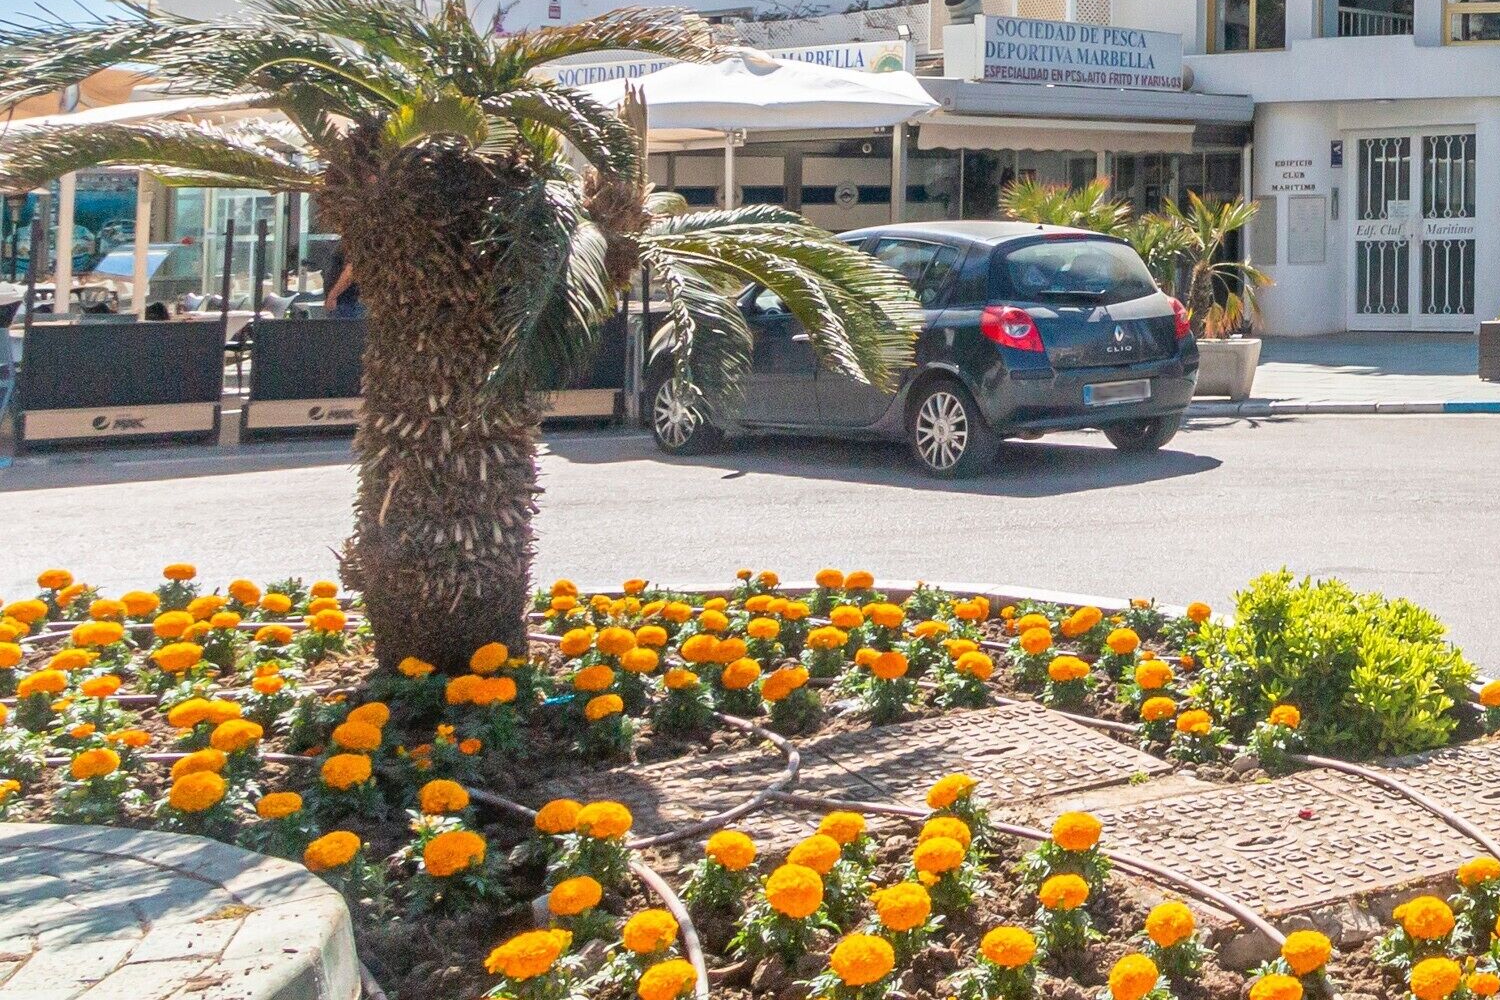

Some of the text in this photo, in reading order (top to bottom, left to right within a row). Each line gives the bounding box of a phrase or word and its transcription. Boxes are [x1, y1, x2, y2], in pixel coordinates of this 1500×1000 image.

[996, 19, 1147, 48] SOCIEDAD DE PESCA
[985, 41, 1155, 69] DEPORTIVA MARBELLA
[557, 66, 625, 87] SOCIEDAD
[629, 64, 647, 79] DE
[984, 64, 1049, 81] ESPECIALIDAD
[1051, 69, 1063, 81] EN
[1109, 72, 1132, 85] FRITO
[1134, 74, 1141, 86] Y
[1106, 345, 1133, 353] CLIO
